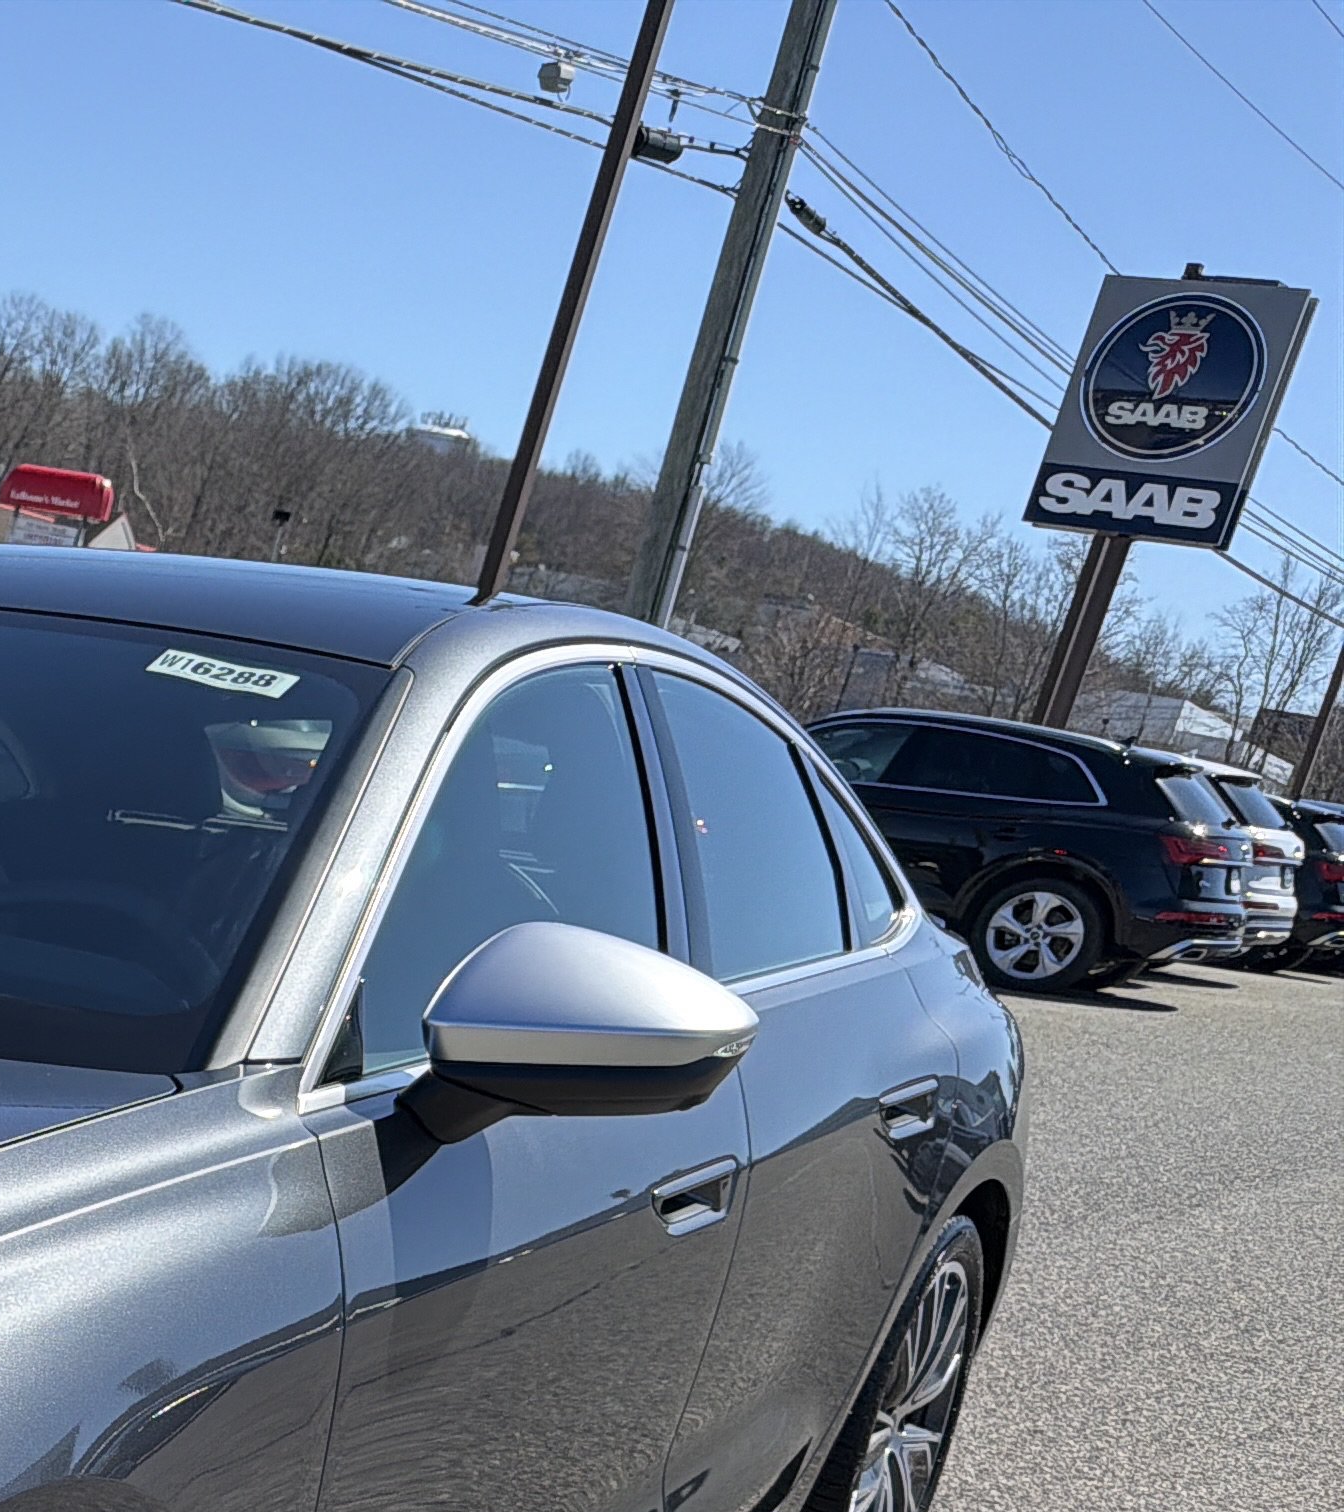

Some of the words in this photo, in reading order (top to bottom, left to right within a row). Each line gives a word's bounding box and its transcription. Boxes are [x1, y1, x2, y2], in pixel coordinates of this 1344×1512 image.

[1105, 400, 1209, 430] SAAB
[1038, 472, 1221, 529] SAAB
[161, 653, 279, 688] W16288
